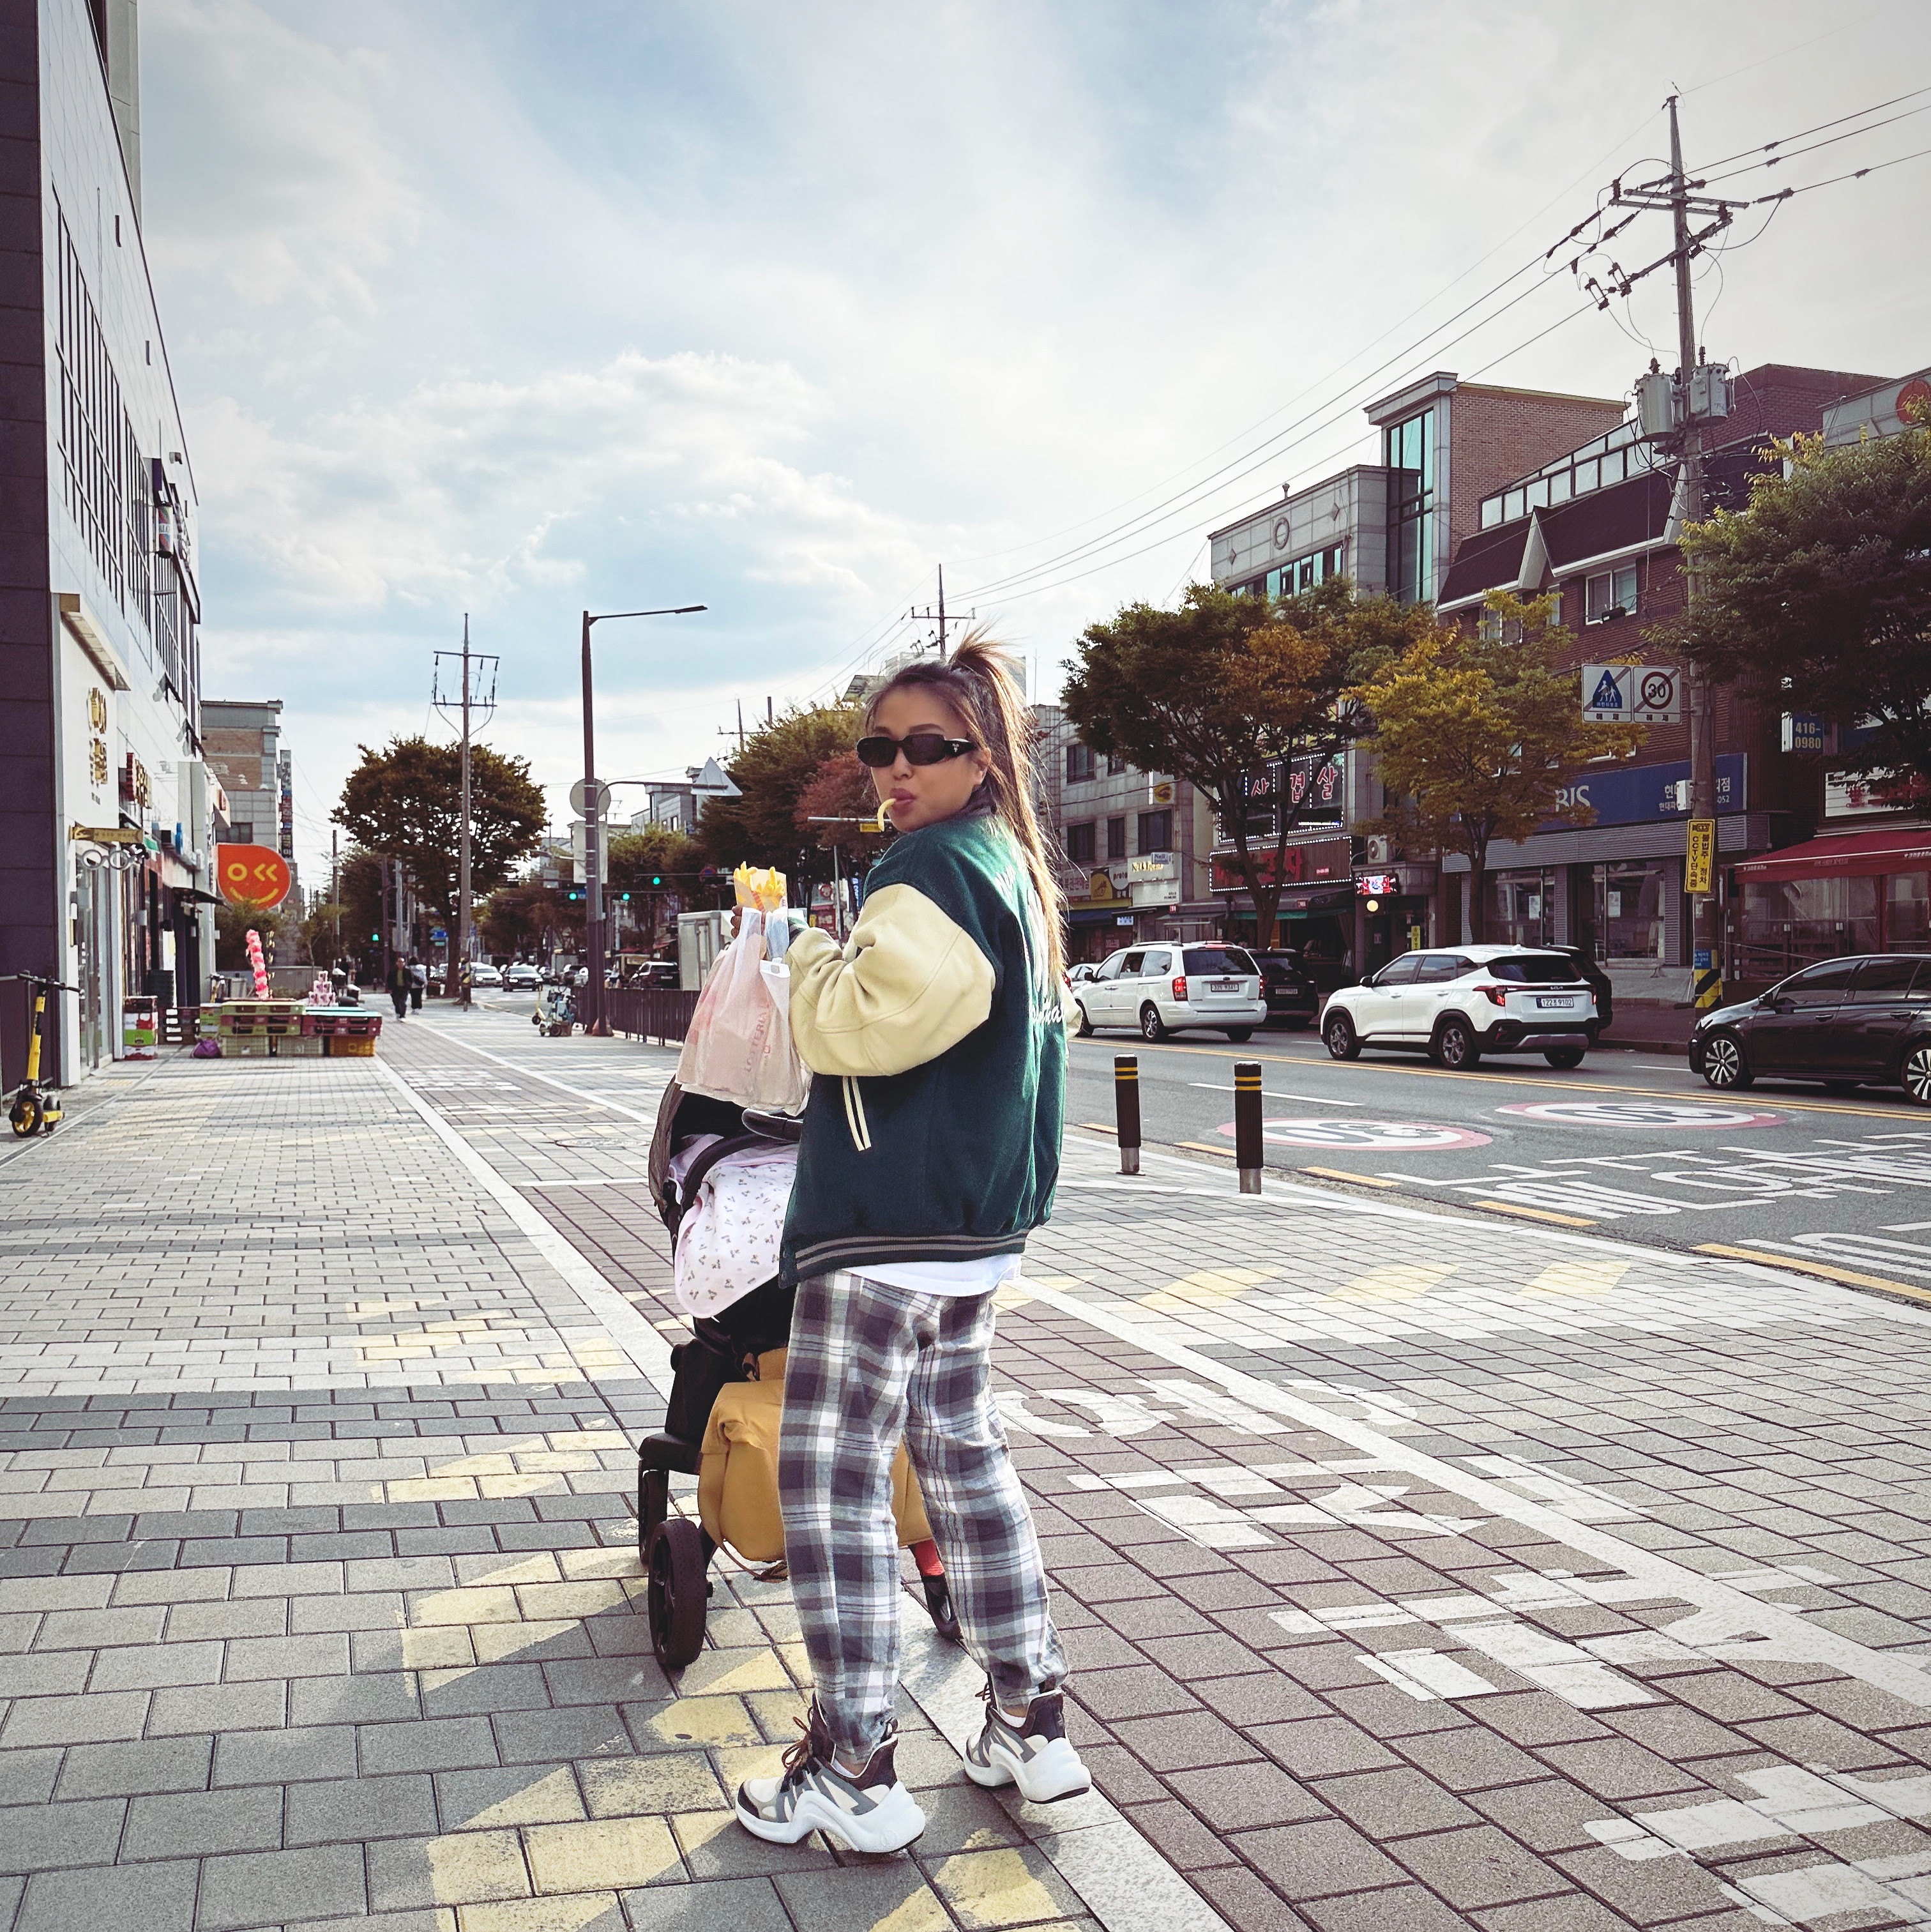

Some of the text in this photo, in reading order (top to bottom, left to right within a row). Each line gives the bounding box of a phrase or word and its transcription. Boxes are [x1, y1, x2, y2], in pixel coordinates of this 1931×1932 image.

[1648, 683, 1666, 698] 30
[1795, 722, 1821, 734] 416-
[1795, 736, 1821, 749] 0980
[1690, 835, 1699, 888] CCTV단속중
[1545, 1105, 1734, 1123] 30
